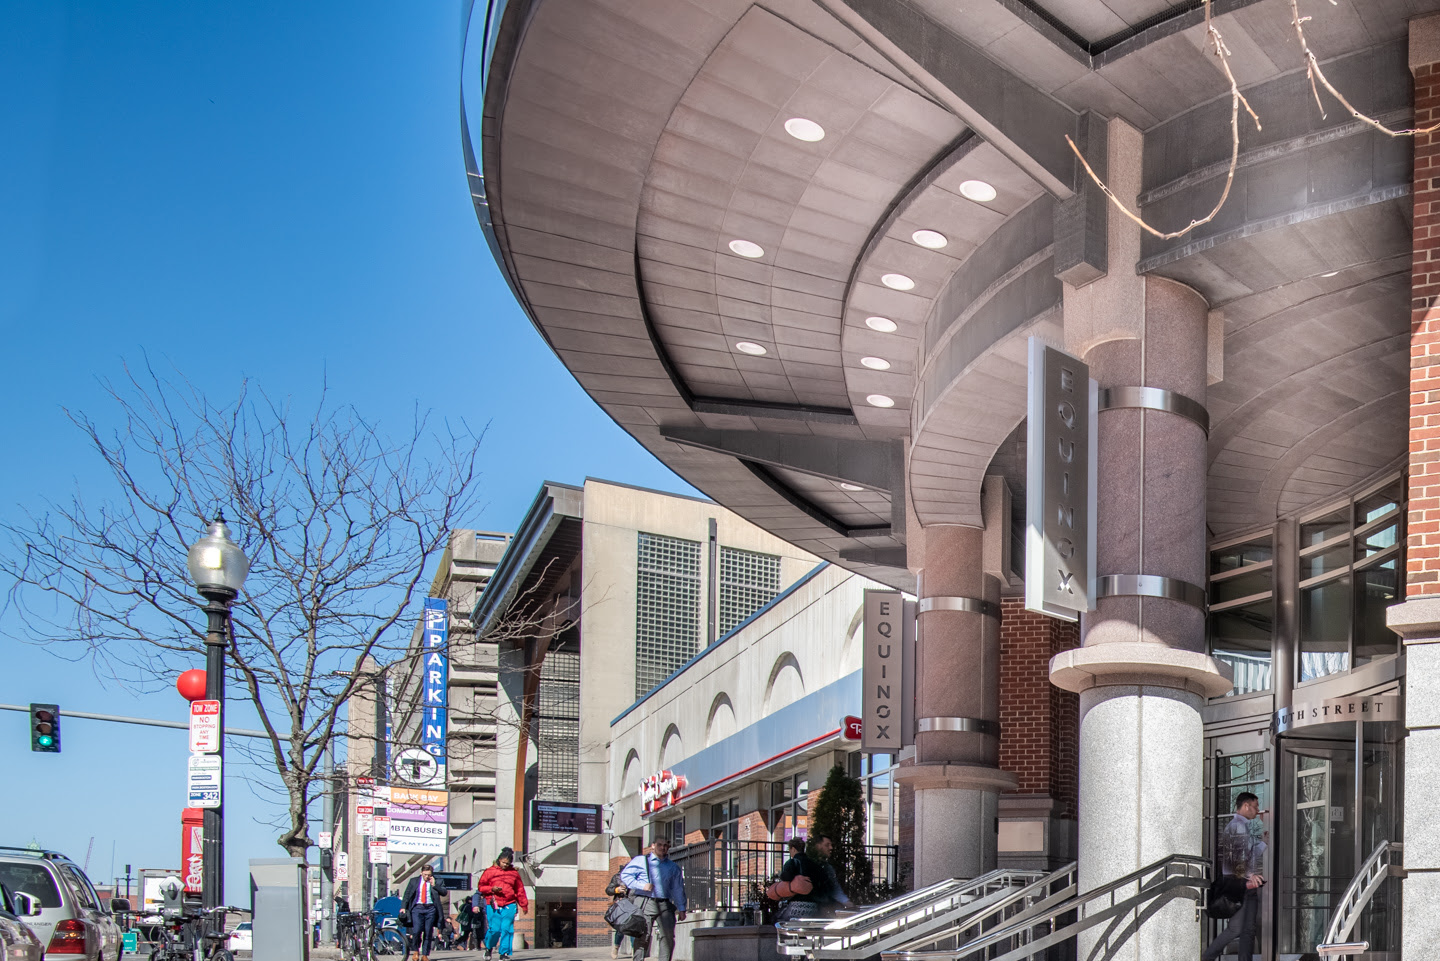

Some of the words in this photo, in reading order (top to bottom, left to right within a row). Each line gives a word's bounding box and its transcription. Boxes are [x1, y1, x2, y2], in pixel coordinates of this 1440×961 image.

[1057, 367, 1077, 595] EQUINOX
[876, 601, 892, 740] EQUINOX
[426, 634, 442, 756] PARKING
[193, 704, 203, 712] TOW
[204, 704, 218, 712] ZONE
[1312, 702, 1383, 718] STREET
[202, 792, 218, 800] 342
[394, 792, 418, 800] BACK
[420, 794, 439, 802] BAY
[413, 826, 443, 834] BUSES
